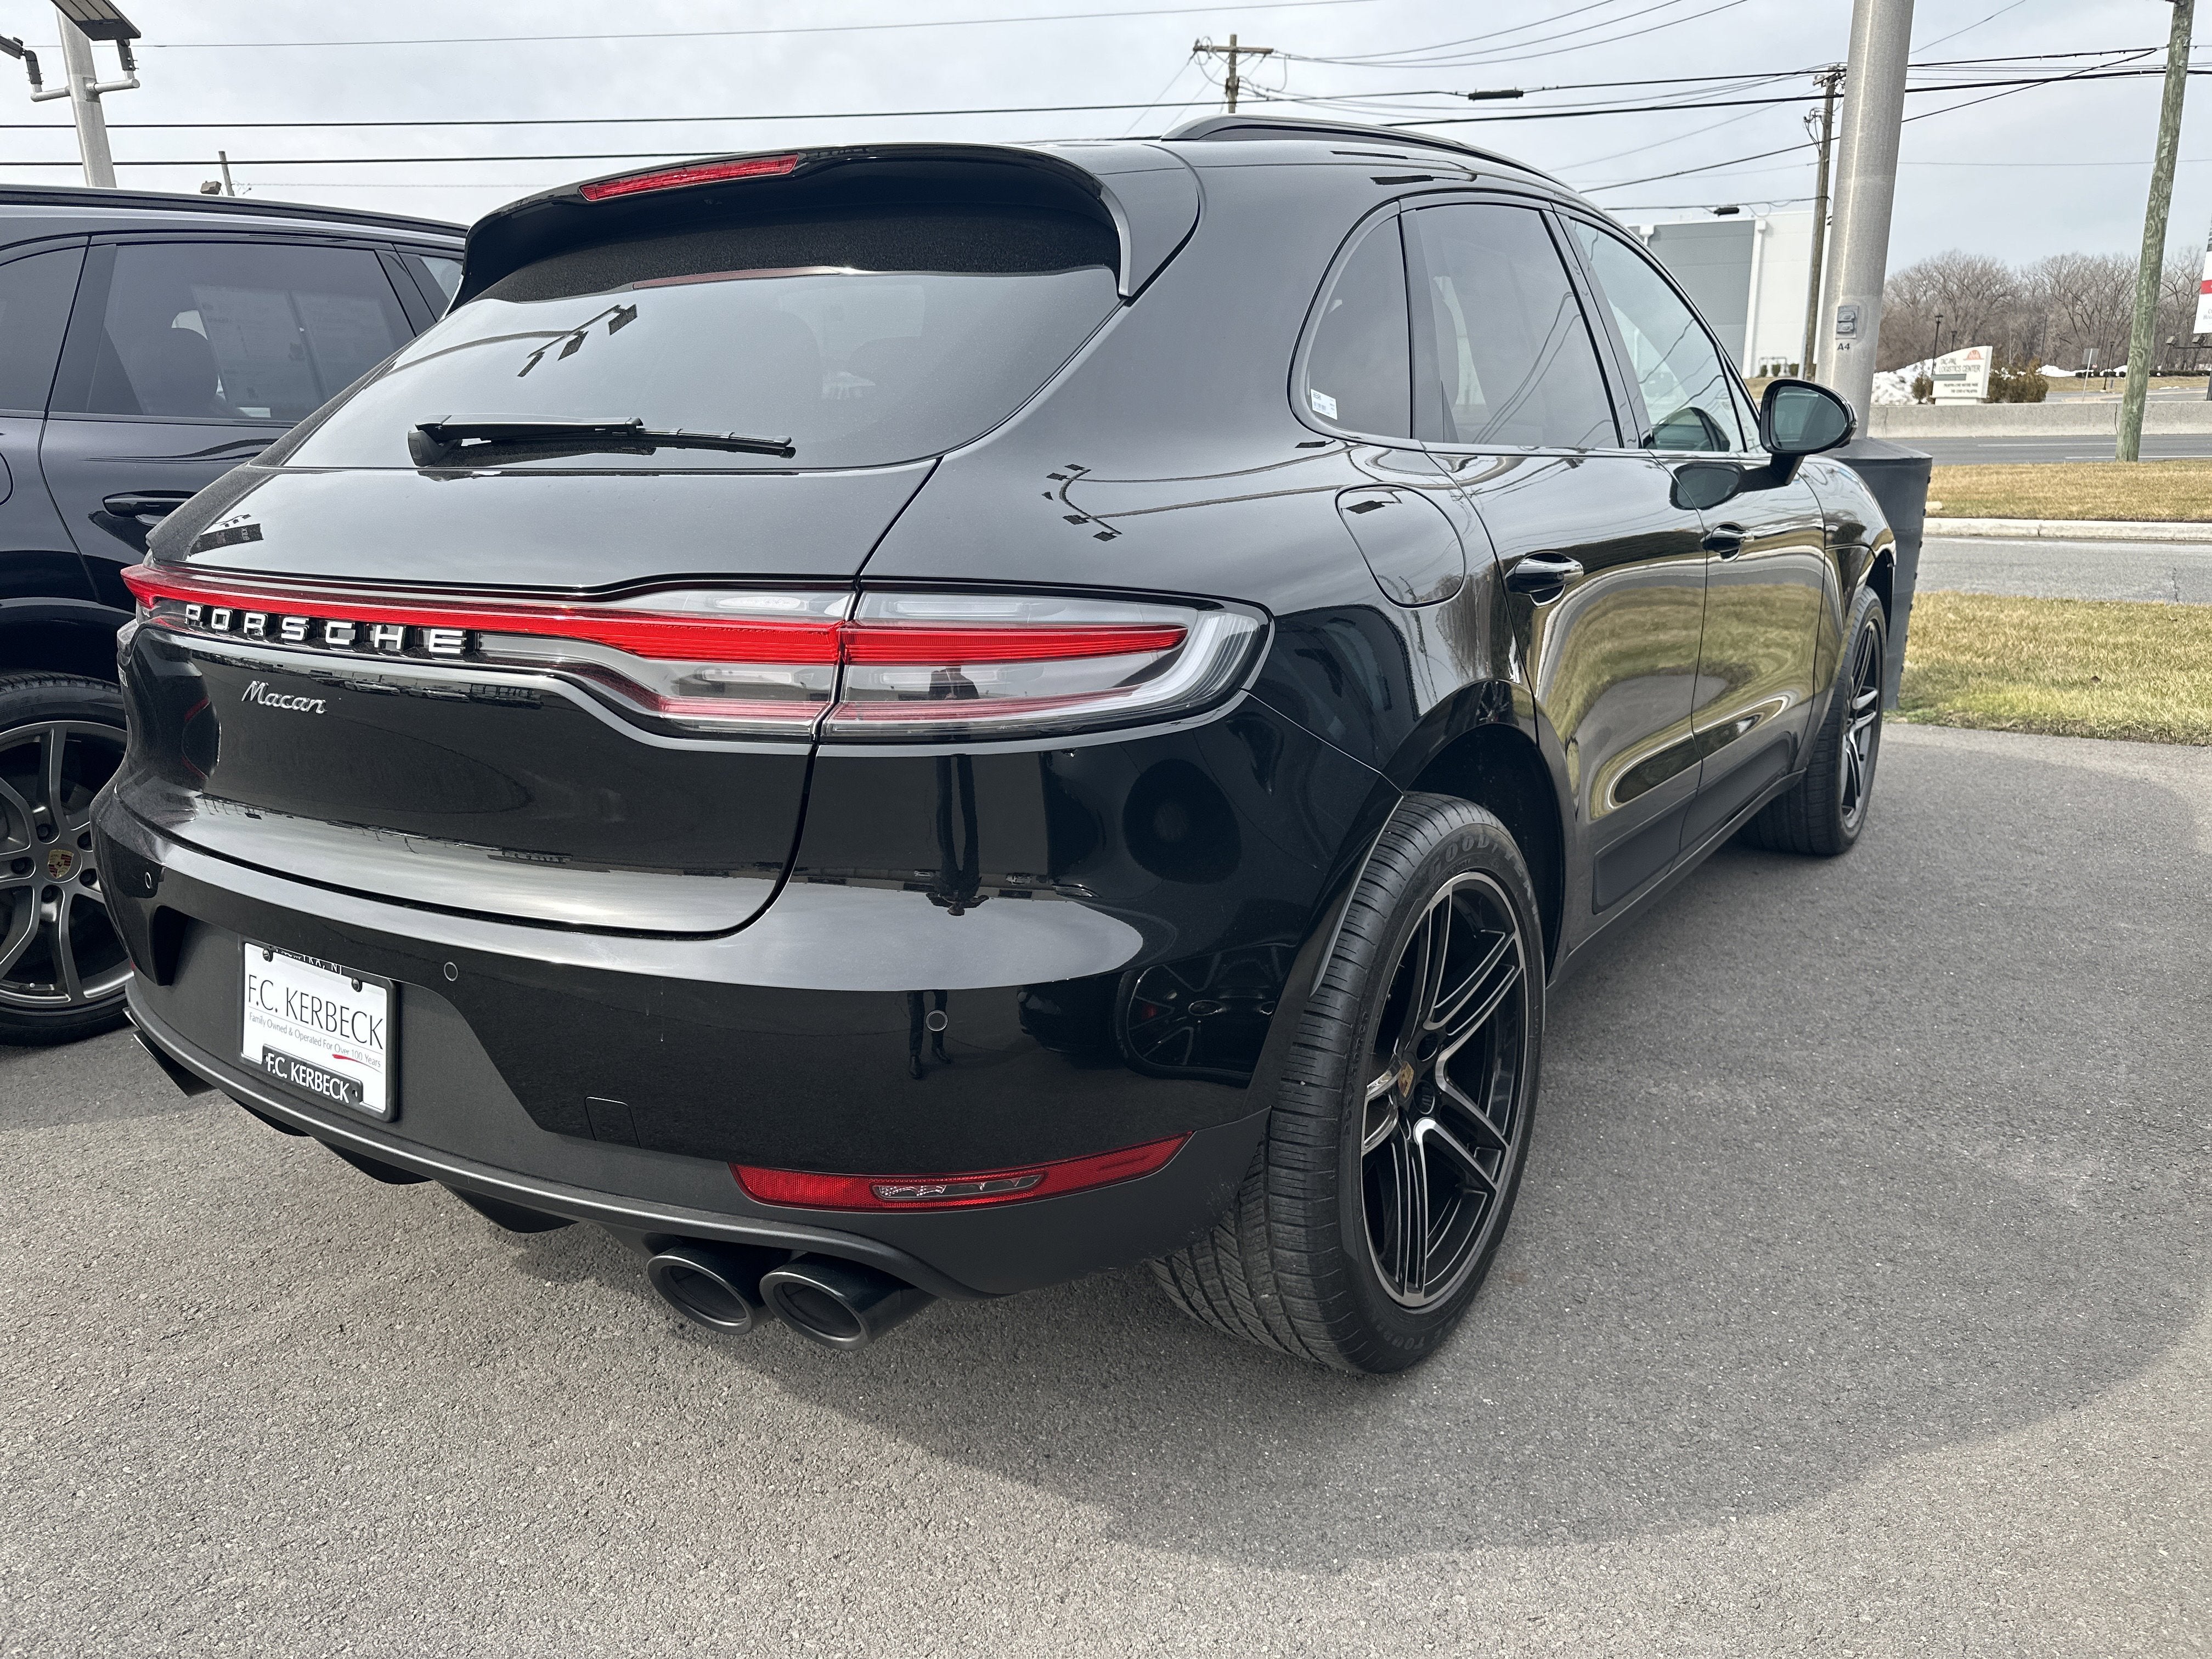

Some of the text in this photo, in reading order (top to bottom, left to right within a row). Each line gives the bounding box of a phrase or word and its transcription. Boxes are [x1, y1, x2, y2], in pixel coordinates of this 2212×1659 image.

[1837, 342, 1850, 351] A4
[1962, 364, 1980, 373] CENTER
[185, 603, 466, 656] PORSCHE
[241, 680, 328, 714] Macan
[248, 974, 383, 1049] F.C. KERBECK
[249, 1012, 381, 1068] Family Owned & Operated For Over 100 Years
[267, 1052, 350, 1104] F.C. KERBECK
